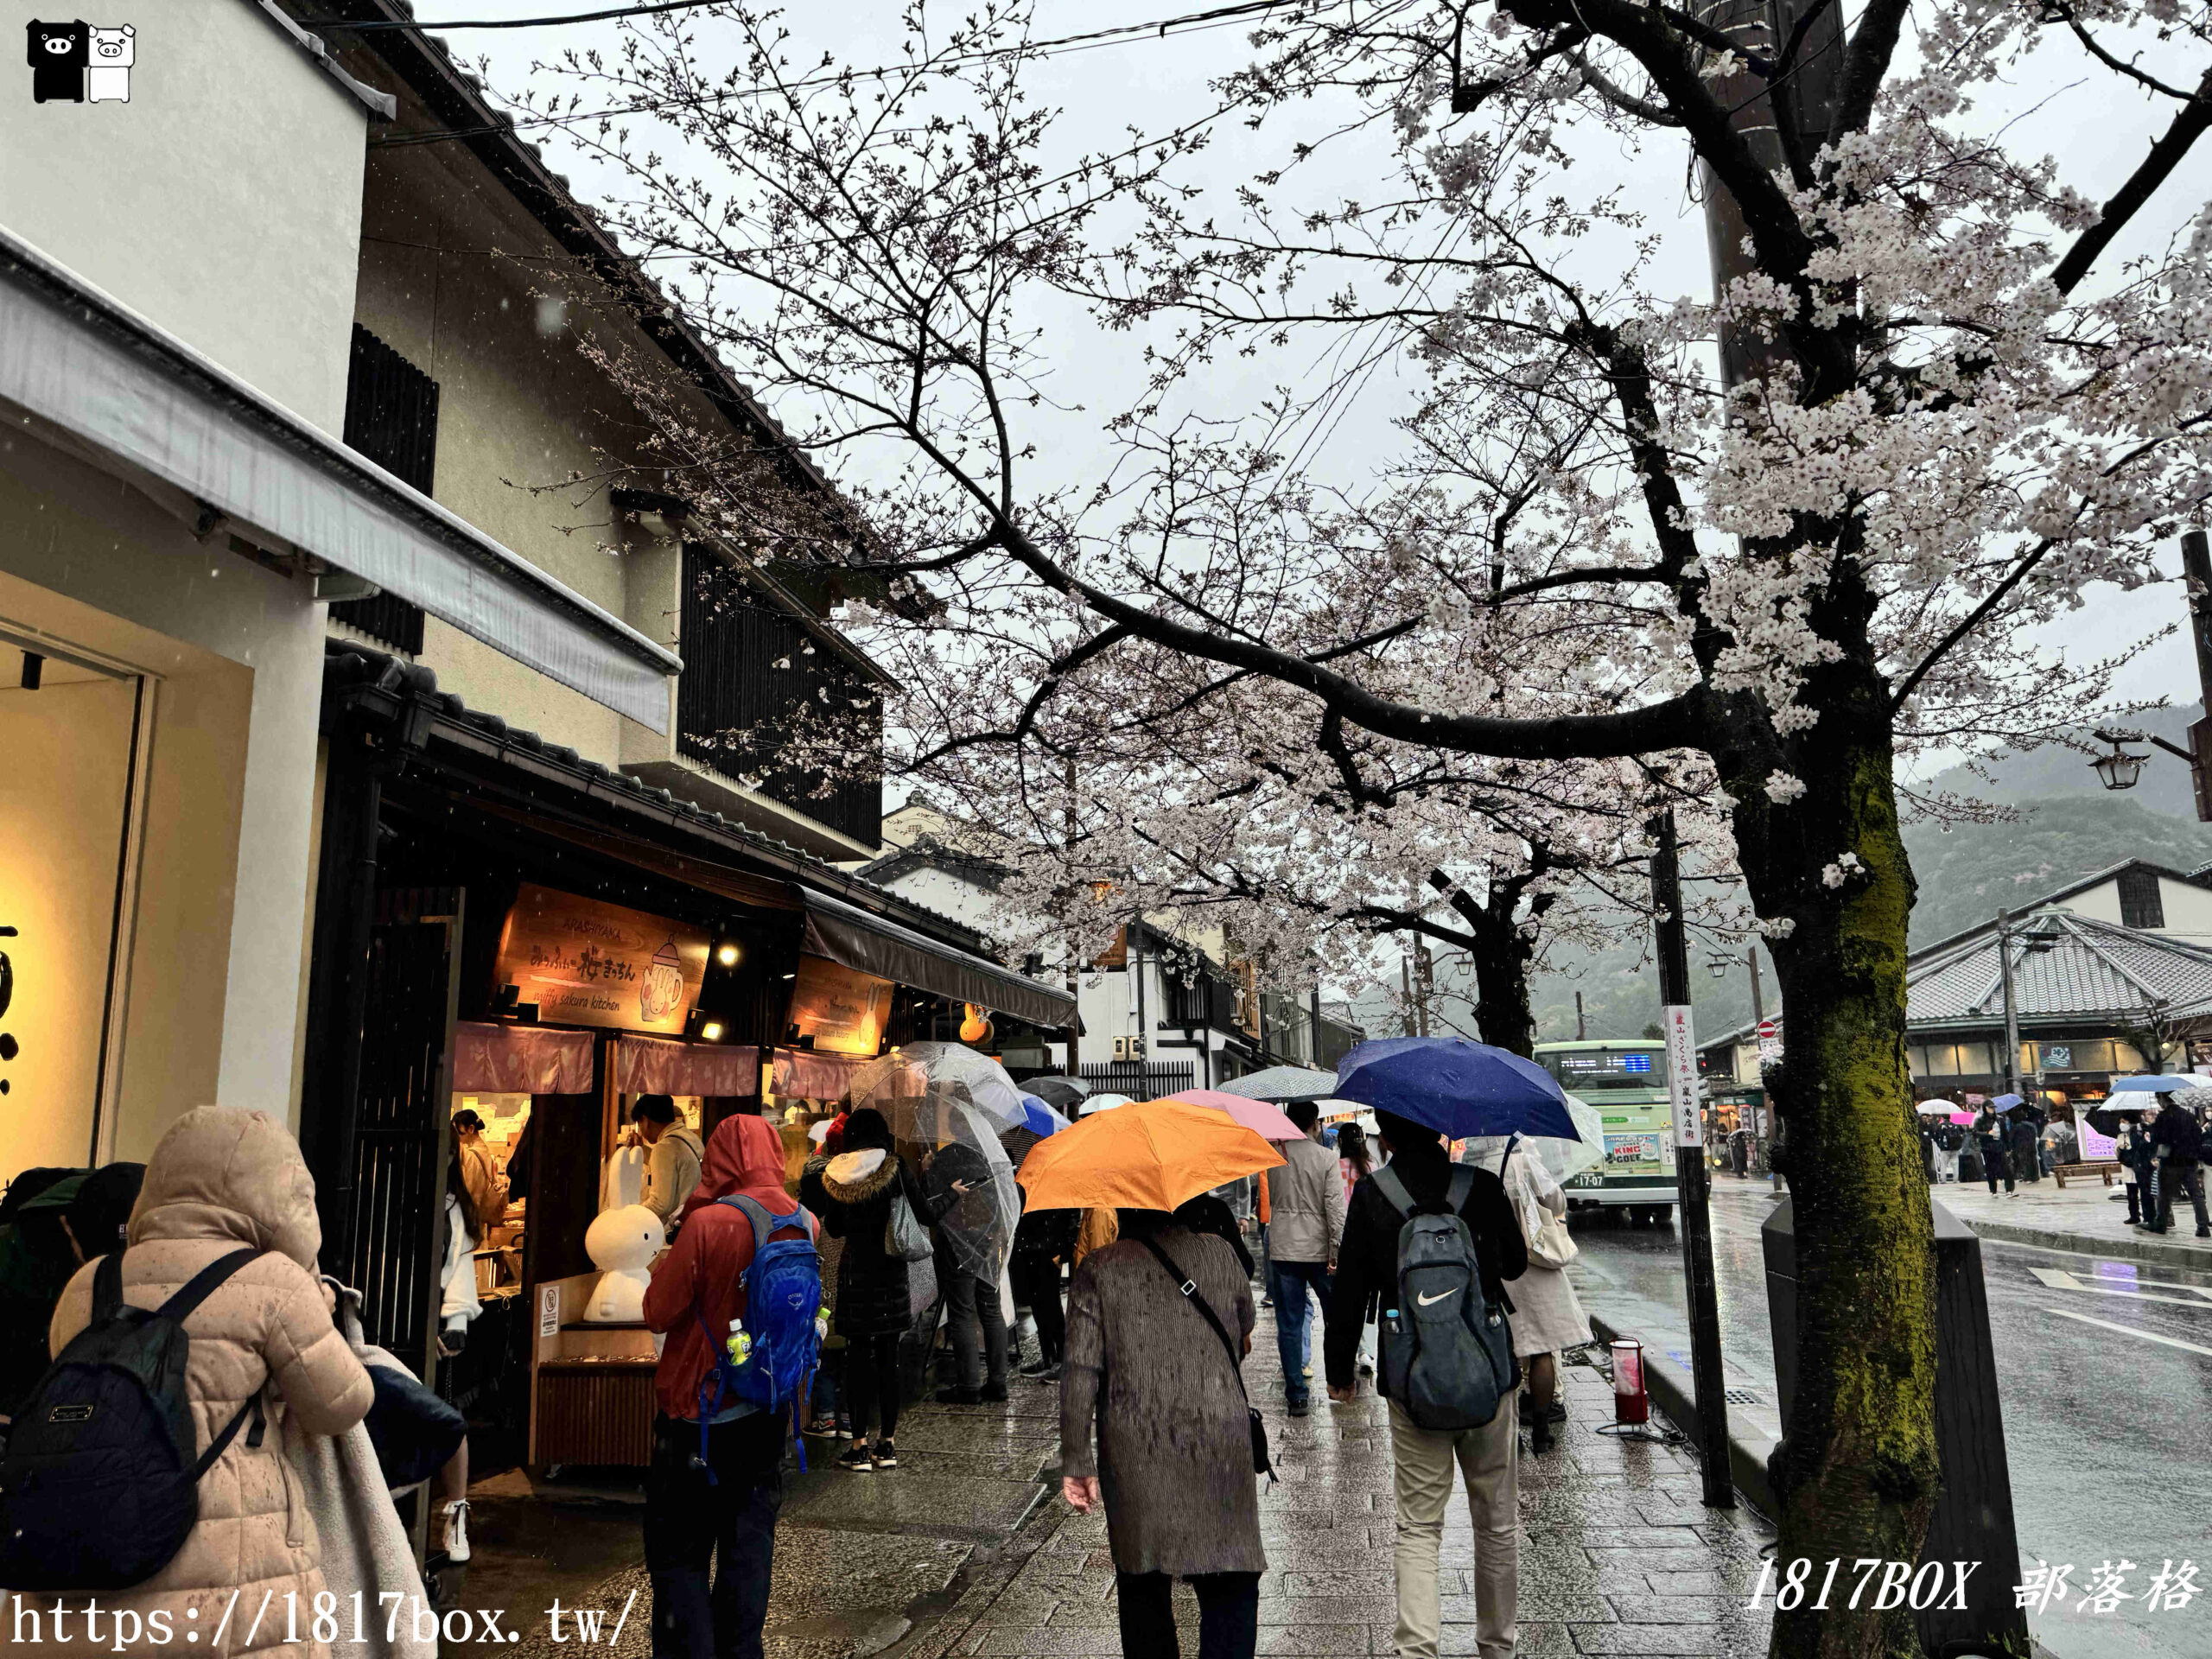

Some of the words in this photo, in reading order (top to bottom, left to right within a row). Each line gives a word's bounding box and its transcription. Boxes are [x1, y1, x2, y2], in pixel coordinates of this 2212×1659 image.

[563, 918, 621, 941] ARASHIYAMA
[532, 988, 557, 1009] miffy
[560, 992, 588, 1008] sakura
[590, 994, 620, 1012] kitchen
[1681, 1085, 1694, 1139] 嵐山商店街
[1613, 1145, 1642, 1155] KING
